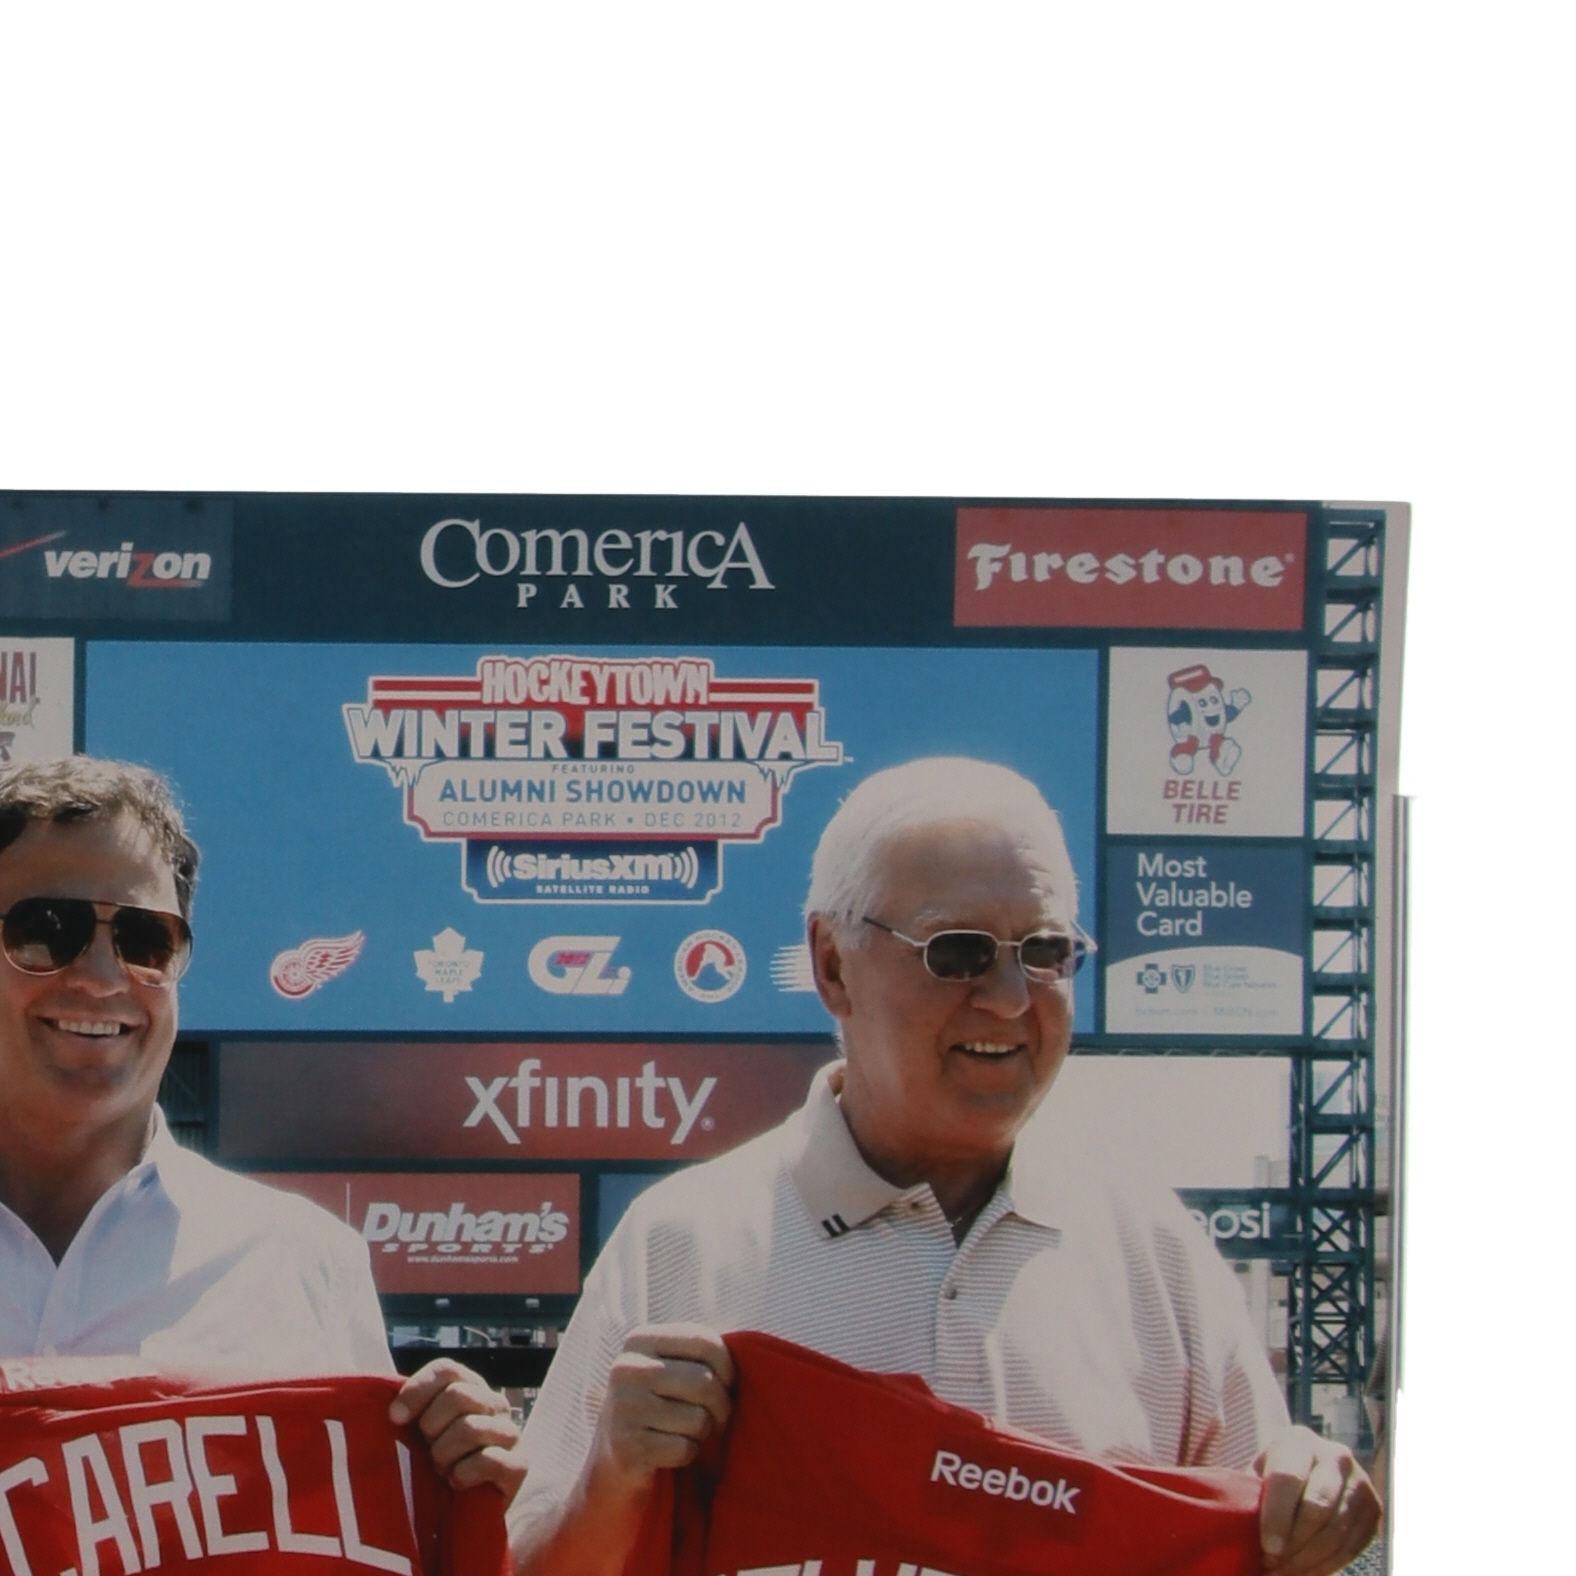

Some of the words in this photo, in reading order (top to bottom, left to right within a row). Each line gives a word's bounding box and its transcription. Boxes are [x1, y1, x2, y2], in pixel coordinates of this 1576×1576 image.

[43, 541, 211, 588] verizon
[967, 542, 1286, 592] Firestone
[517, 584, 678, 609] PARK
[481, 660, 709, 705] HOCKEYTOWN
[345, 708, 567, 760] WINTER
[583, 709, 841, 762] FESTIVAL
[551, 763, 636, 775] FEATURING
[438, 779, 556, 804] ALUMNI
[565, 779, 747, 804] SHOWDOWN
[1162, 779, 1242, 802] BELLE
[442, 811, 553, 827] COMERICA
[562, 811, 617, 827] PARK
[644, 812, 689, 828] DEC
[695, 812, 742, 828] 2012
[1171, 803, 1229, 826] TIRE
[1136, 852, 1207, 880] Most
[535, 885, 604, 895] SATELLITE
[608, 885, 650, 895] RADIO
[1136, 882, 1253, 909] Valuable
[1136, 910, 1204, 937] Card
[463, 1058, 718, 1145] xfinity
[361, 1201, 570, 1243] Dunham's
[381, 1243, 547, 1254] SPORTS
[930, 1449, 1081, 1515] Reebok
